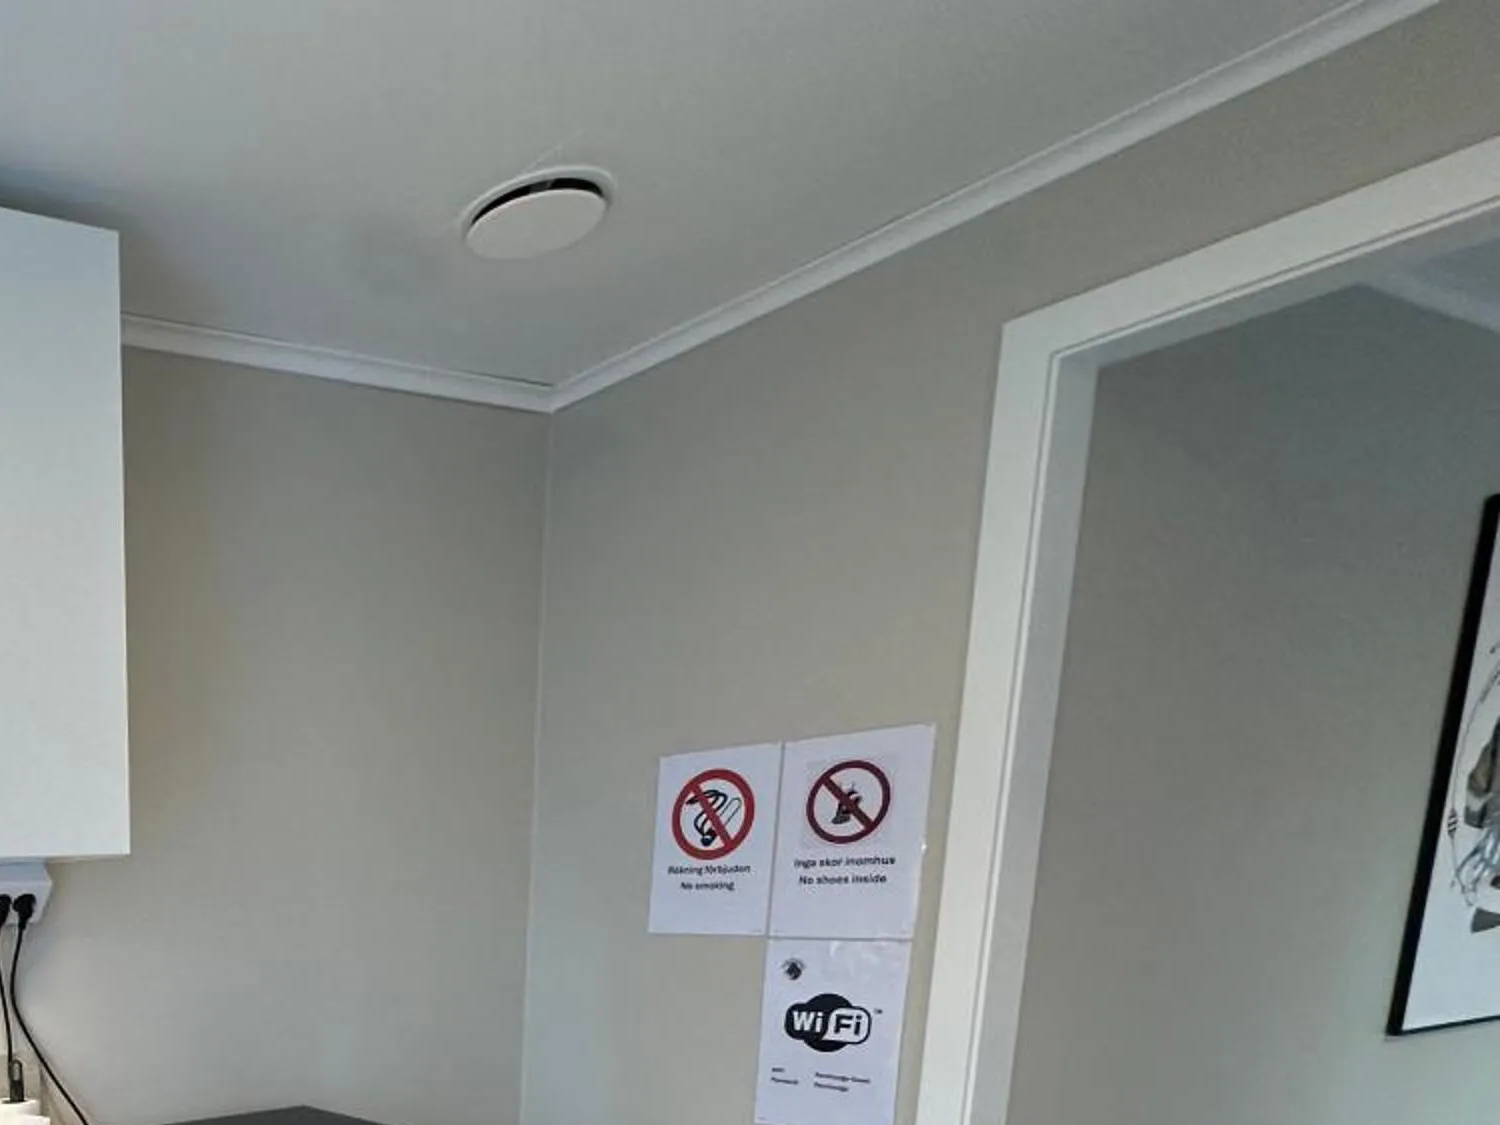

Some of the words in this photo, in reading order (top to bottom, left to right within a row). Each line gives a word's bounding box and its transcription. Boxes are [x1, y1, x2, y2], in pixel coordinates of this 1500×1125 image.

[794, 858, 817, 869] Inga
[819, 857, 842, 867] skor
[799, 874, 814, 885] No
[816, 874, 849, 885] shoes
[851, 872, 887, 884] inside
